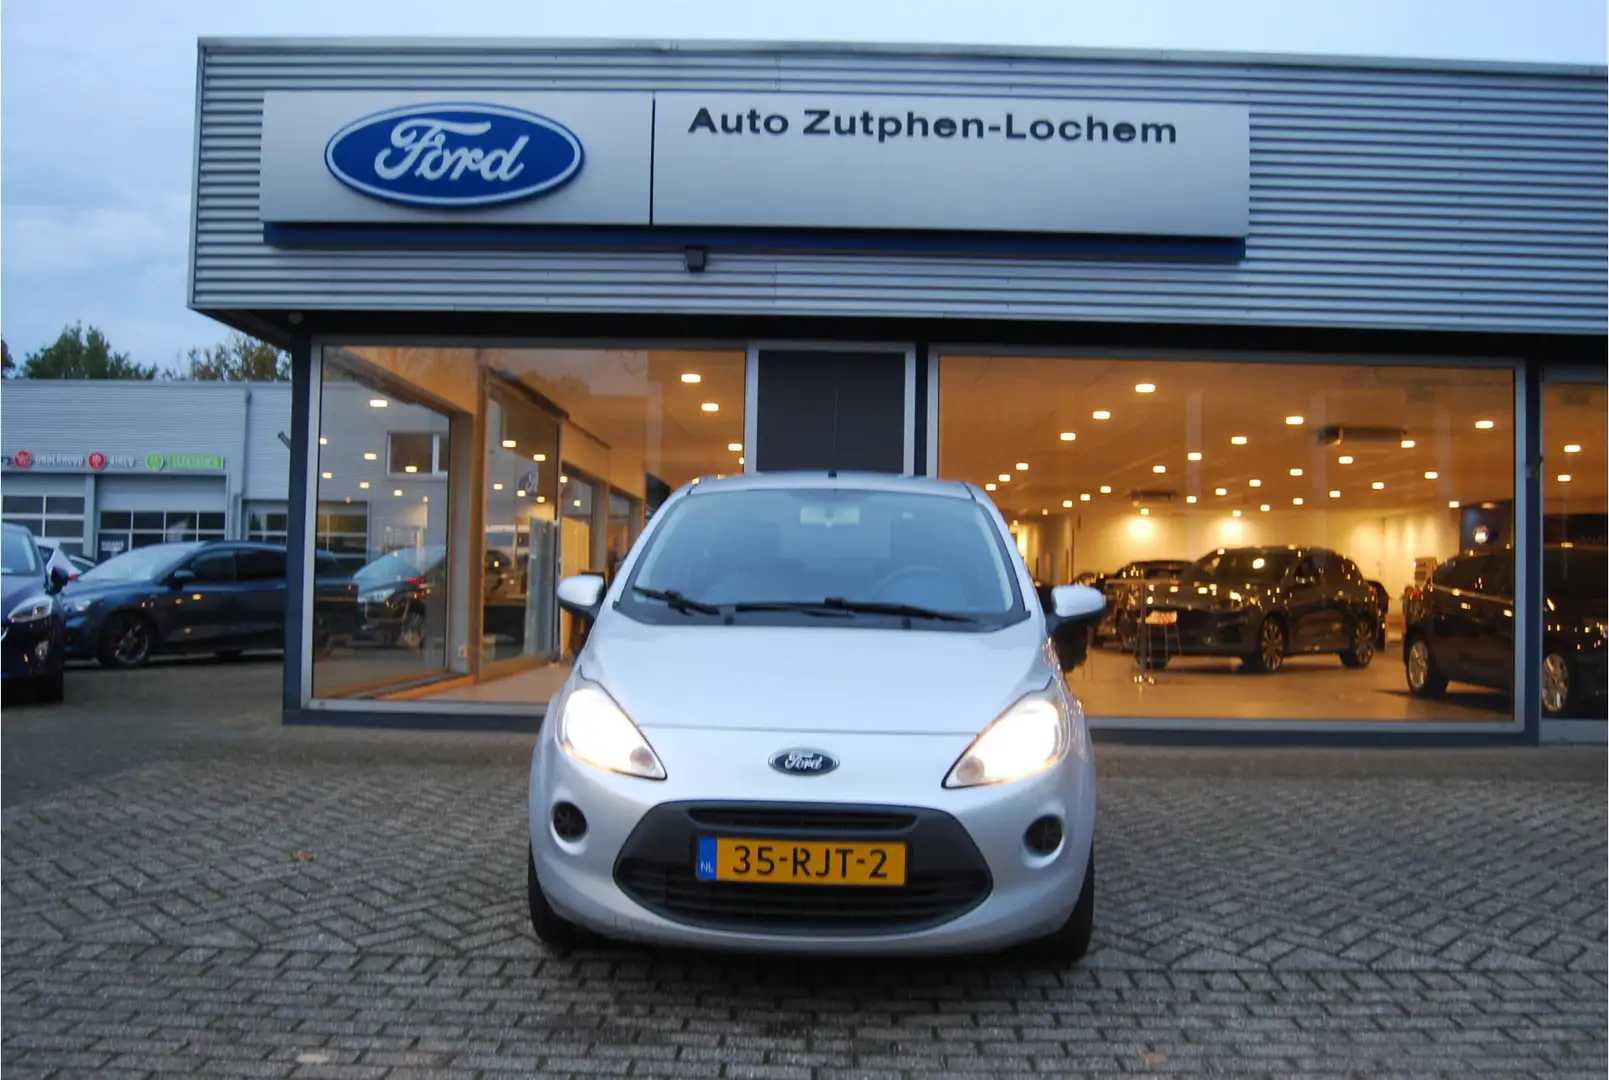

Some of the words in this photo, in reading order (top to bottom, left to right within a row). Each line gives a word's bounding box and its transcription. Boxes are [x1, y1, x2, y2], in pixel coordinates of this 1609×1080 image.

[688, 107, 790, 135] Auto
[802, 109, 1178, 144] Zutphen-Lochem
[374, 118, 529, 181] Ford
[784, 751, 823, 770] Ford
[700, 861, 714, 873] NL
[732, 844, 888, 879] 35-RJT-2
